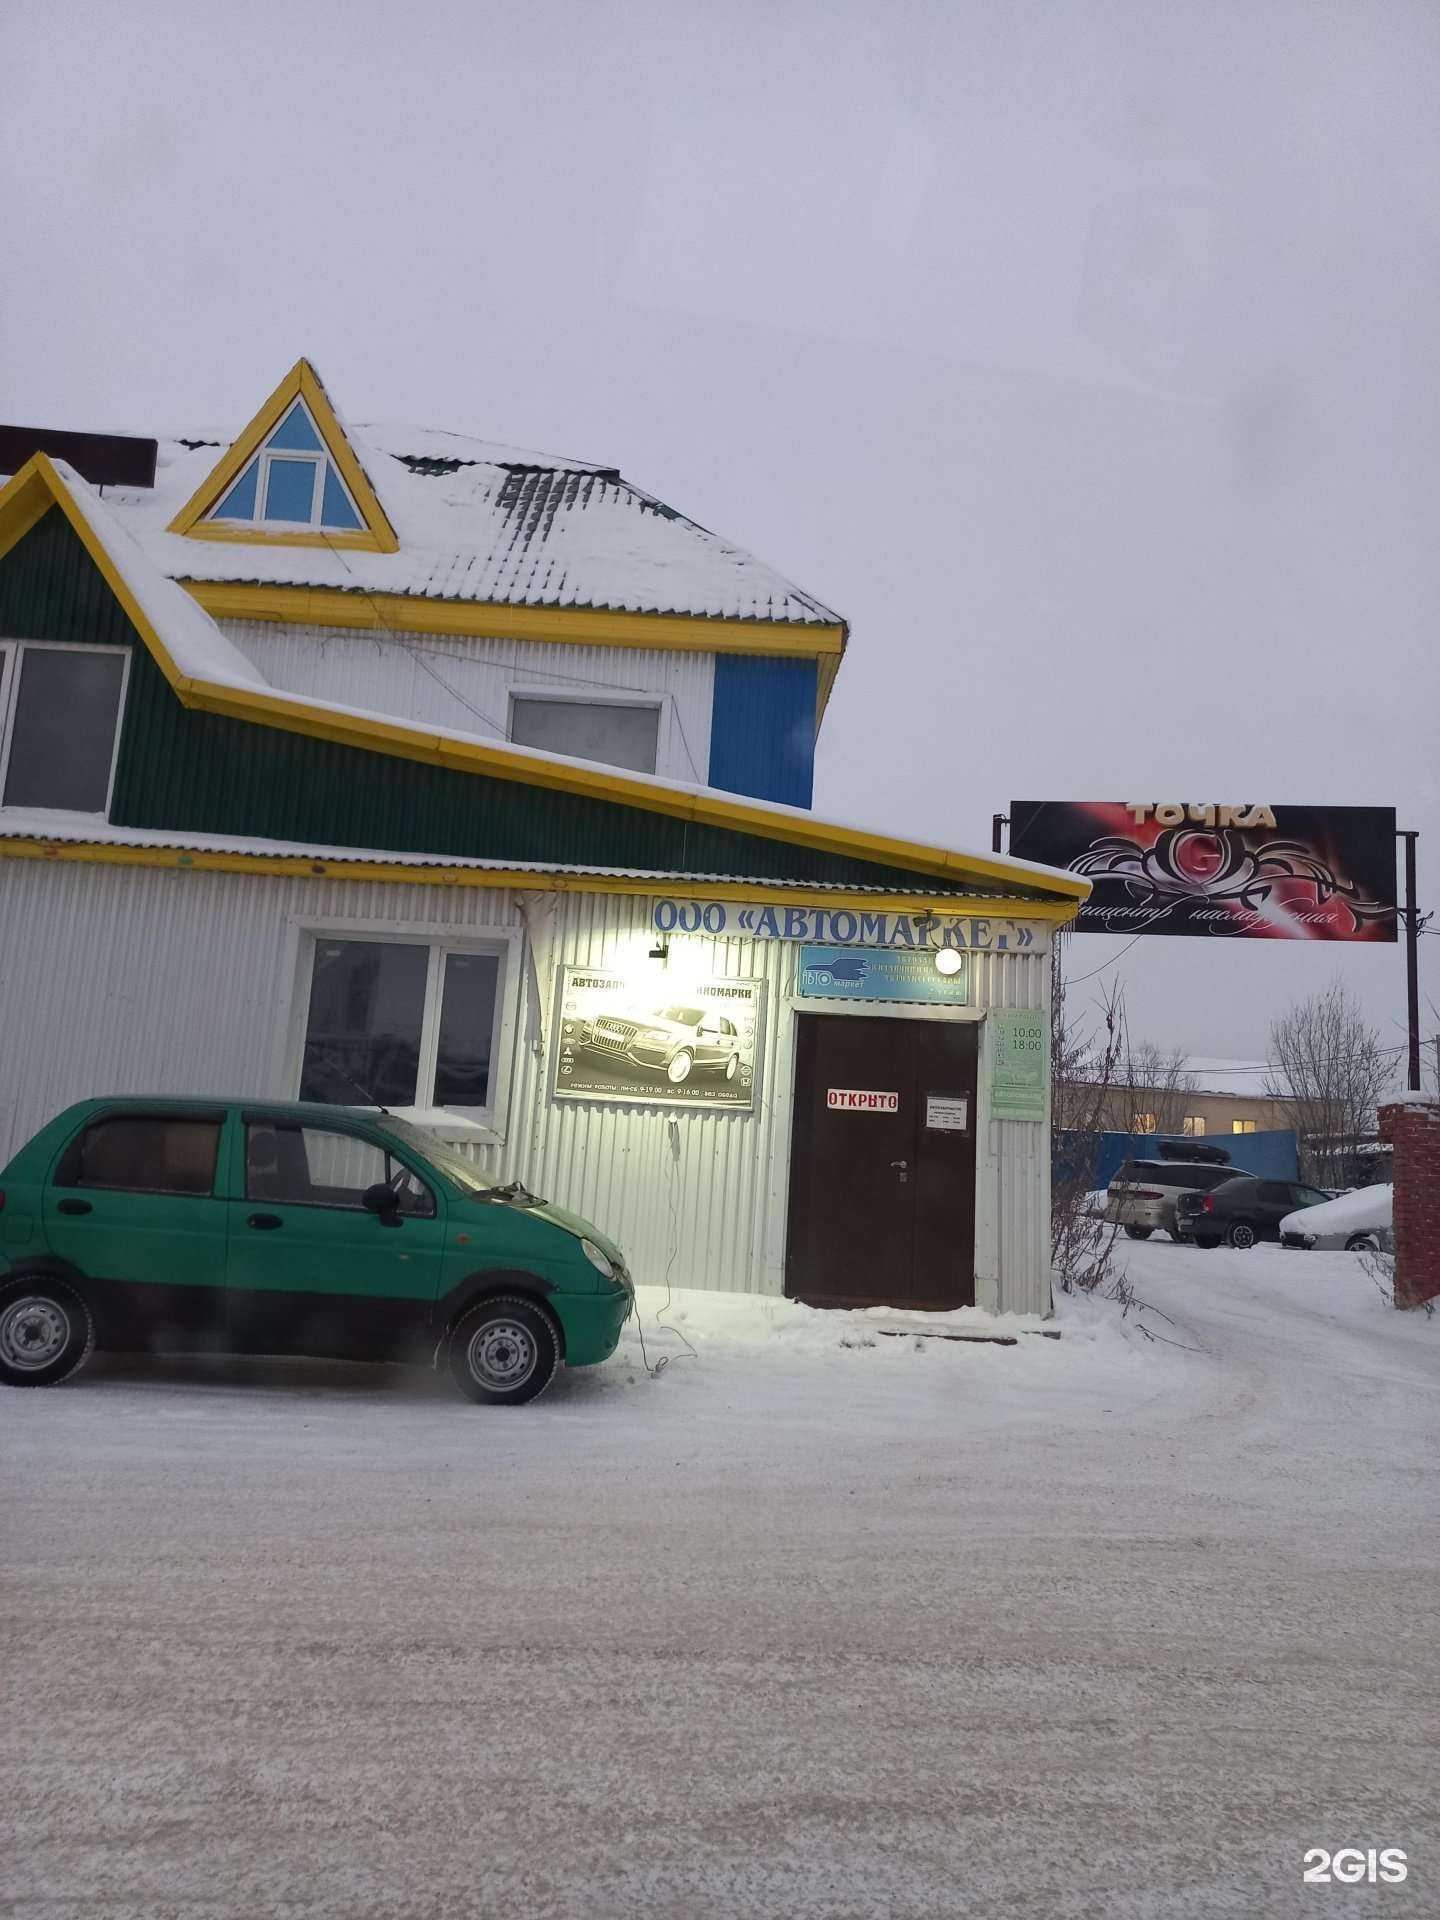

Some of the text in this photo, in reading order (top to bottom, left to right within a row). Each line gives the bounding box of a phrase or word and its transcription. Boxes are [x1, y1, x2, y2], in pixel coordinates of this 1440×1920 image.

[1127, 803, 1277, 828] ТОЧКА
[654, 900, 726, 933] ООО
[1078, 896, 1338, 935] пицентр насладения
[829, 1092, 897, 1109] ОТКРЫТО
